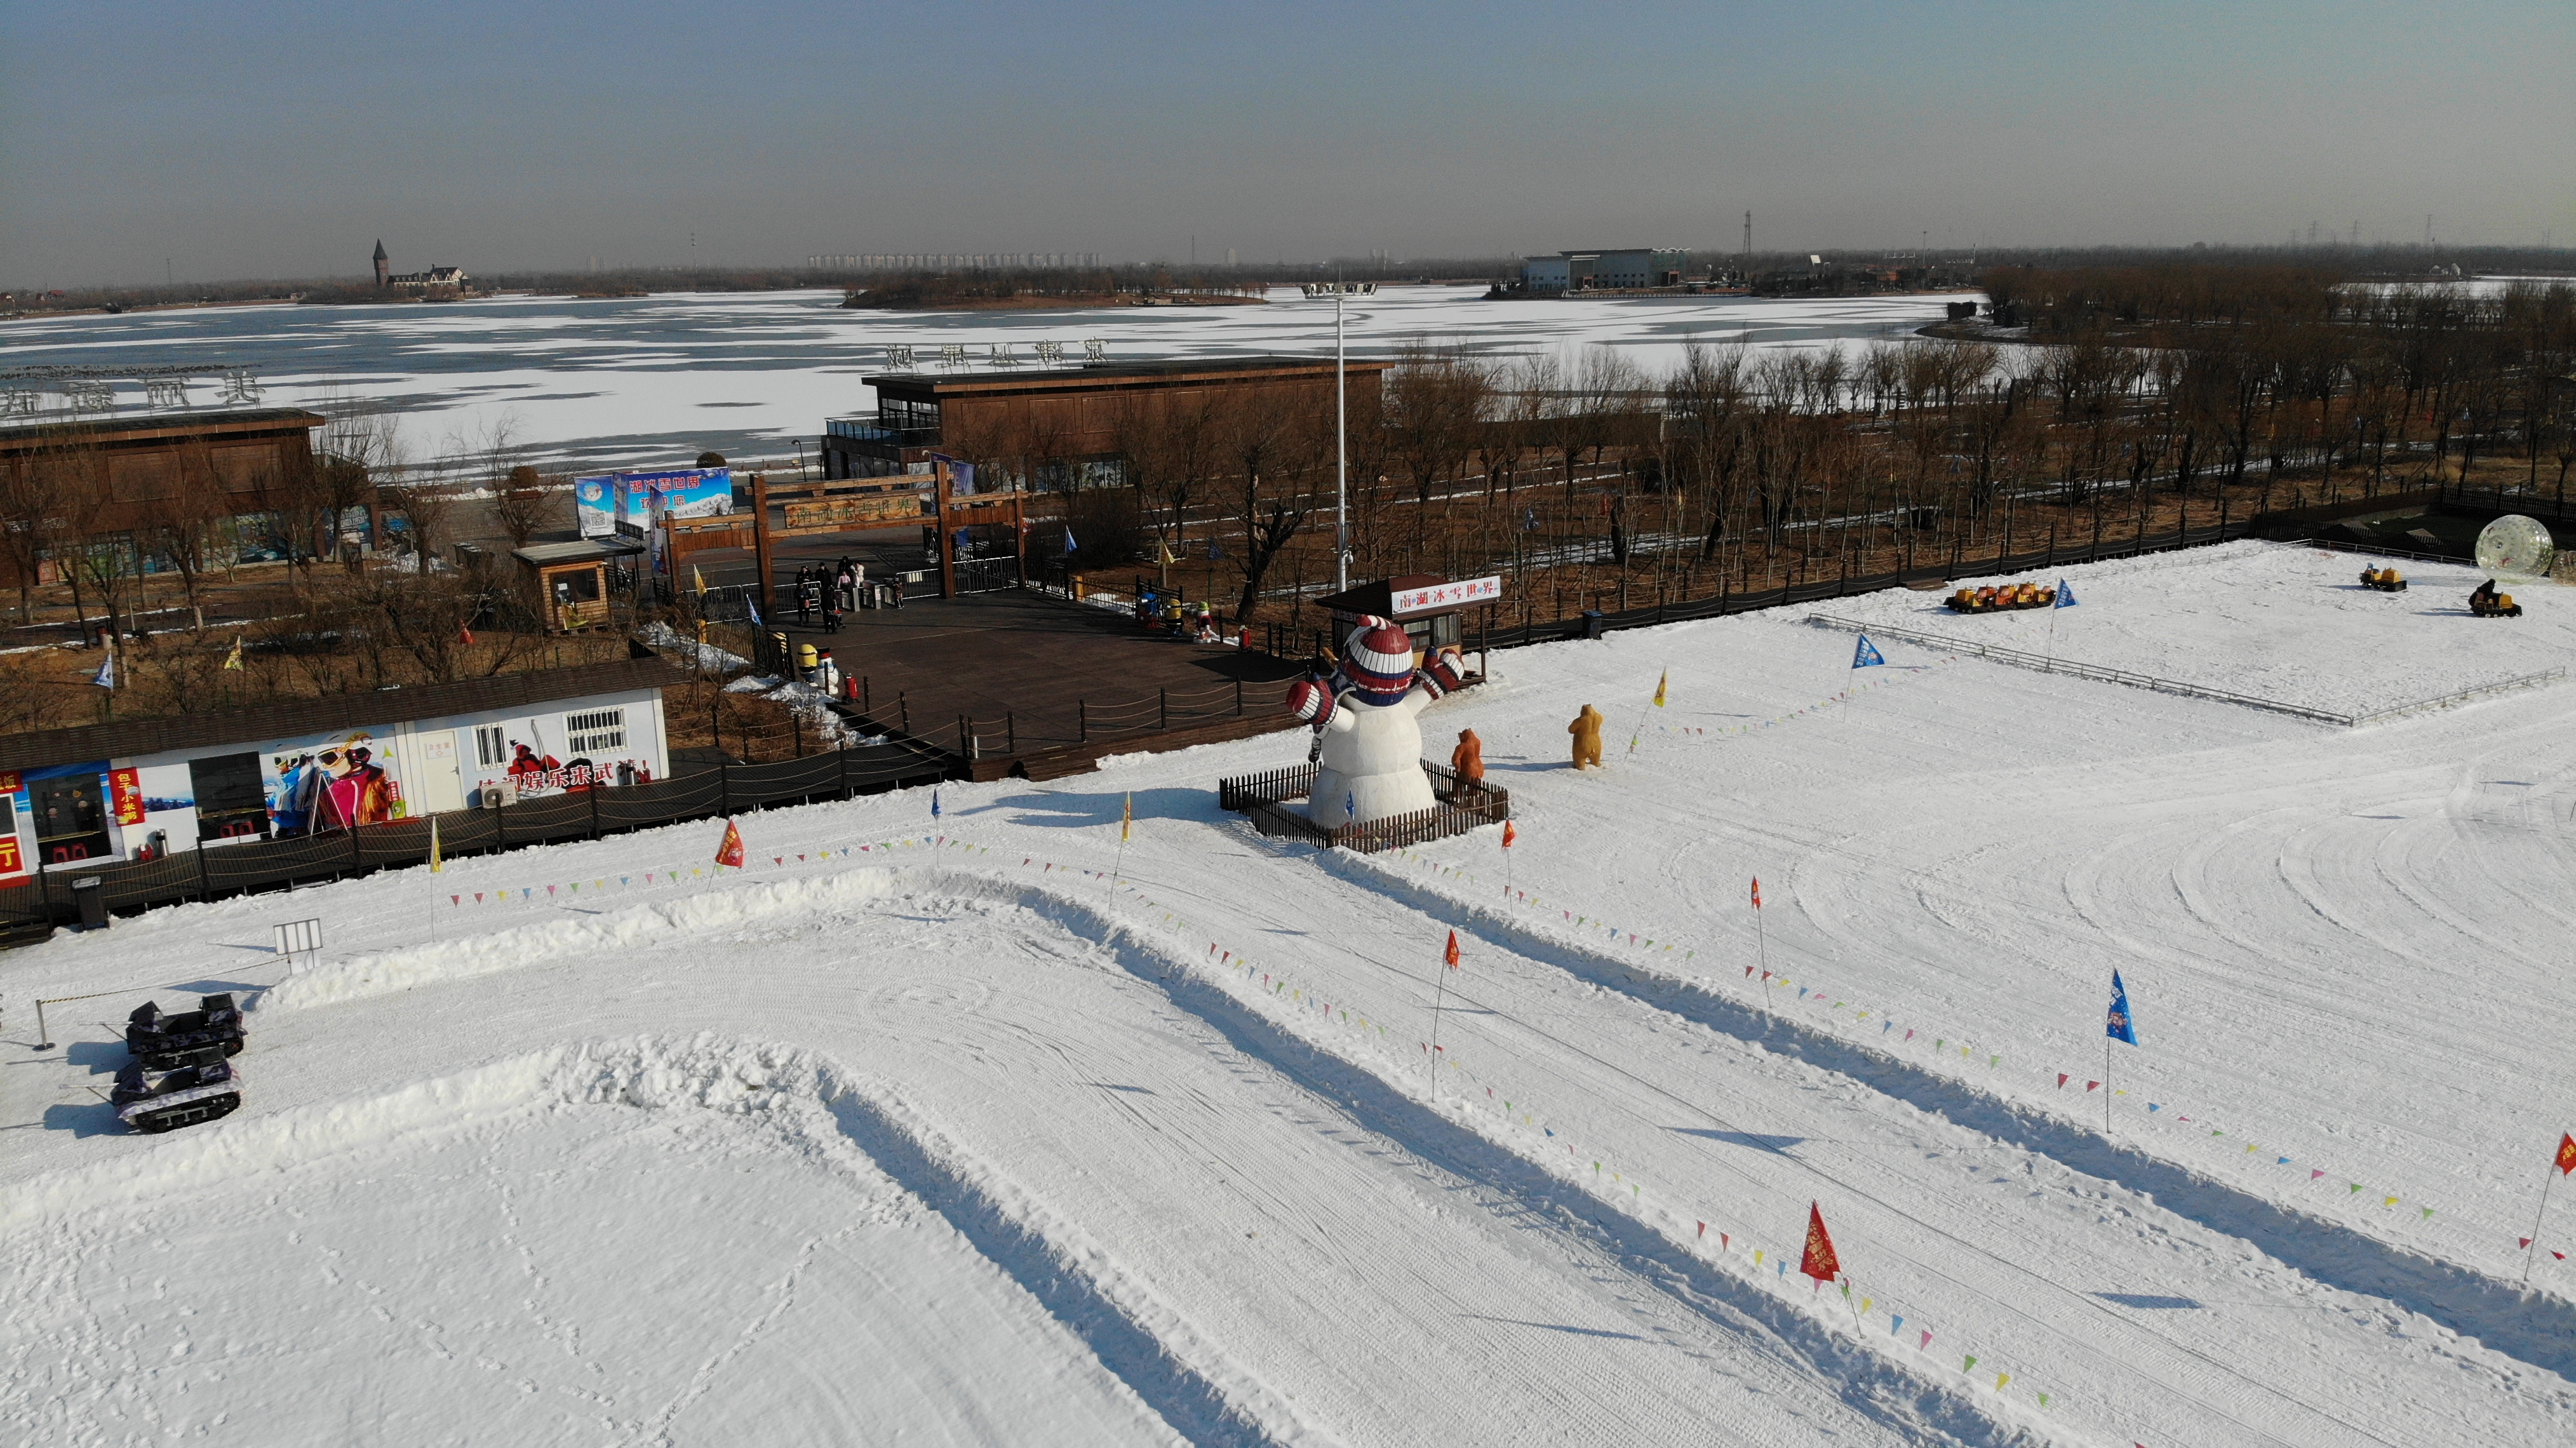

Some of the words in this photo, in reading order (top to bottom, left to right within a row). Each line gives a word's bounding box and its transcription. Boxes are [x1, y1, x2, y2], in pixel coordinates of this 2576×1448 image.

[1399, 580, 1494, 610] 南湖冰雪世界
[117, 773, 137, 821] 包子小米粥
